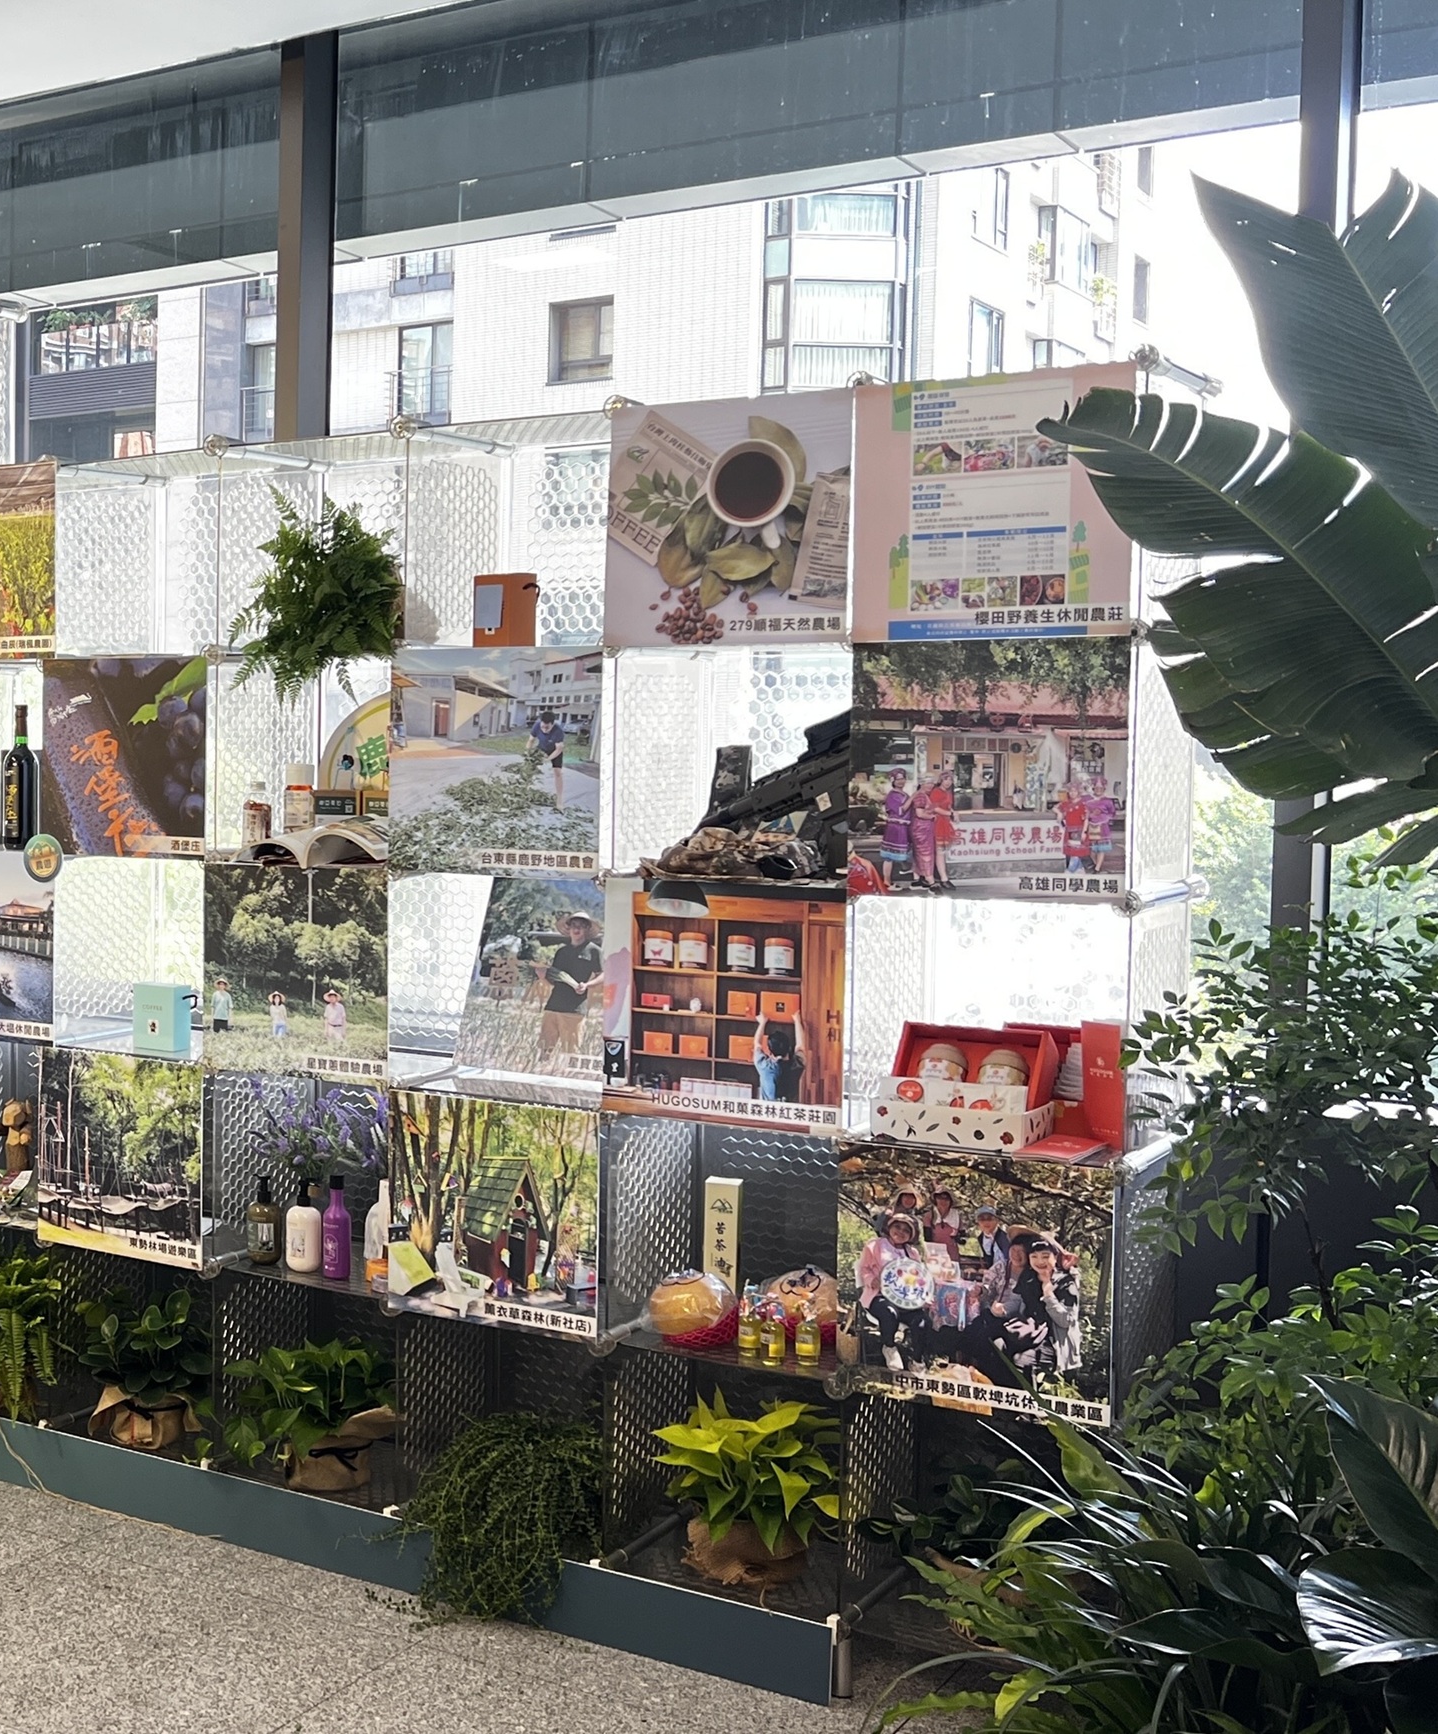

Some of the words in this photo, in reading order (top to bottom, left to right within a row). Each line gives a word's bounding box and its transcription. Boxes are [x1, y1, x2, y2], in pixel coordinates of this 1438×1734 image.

[975, 606, 1124, 625] 櫻田野養生休閒農莊
[729, 618, 841, 632] 279順福天然農場
[955, 826, 1062, 846] 高雄同學農場
[171, 840, 200, 851] 酒堡庄
[950, 847, 1001, 857] Kaohsiung
[1005, 846, 1036, 855] School
[1040, 845, 1063, 853] Farm
[481, 852, 594, 869] 台東縣鹿野地區農會
[1019, 876, 1118, 893] 高雄同學農場
[307, 1058, 383, 1076] 星寶蔥體驗農場
[652, 1093, 836, 1125] HUGOSUM和菓森林紅茶莊園
[129, 1236, 196, 1260] 東勢林場遊樂區
[484, 1302, 592, 1333] 薰衣草森林(新社店)
